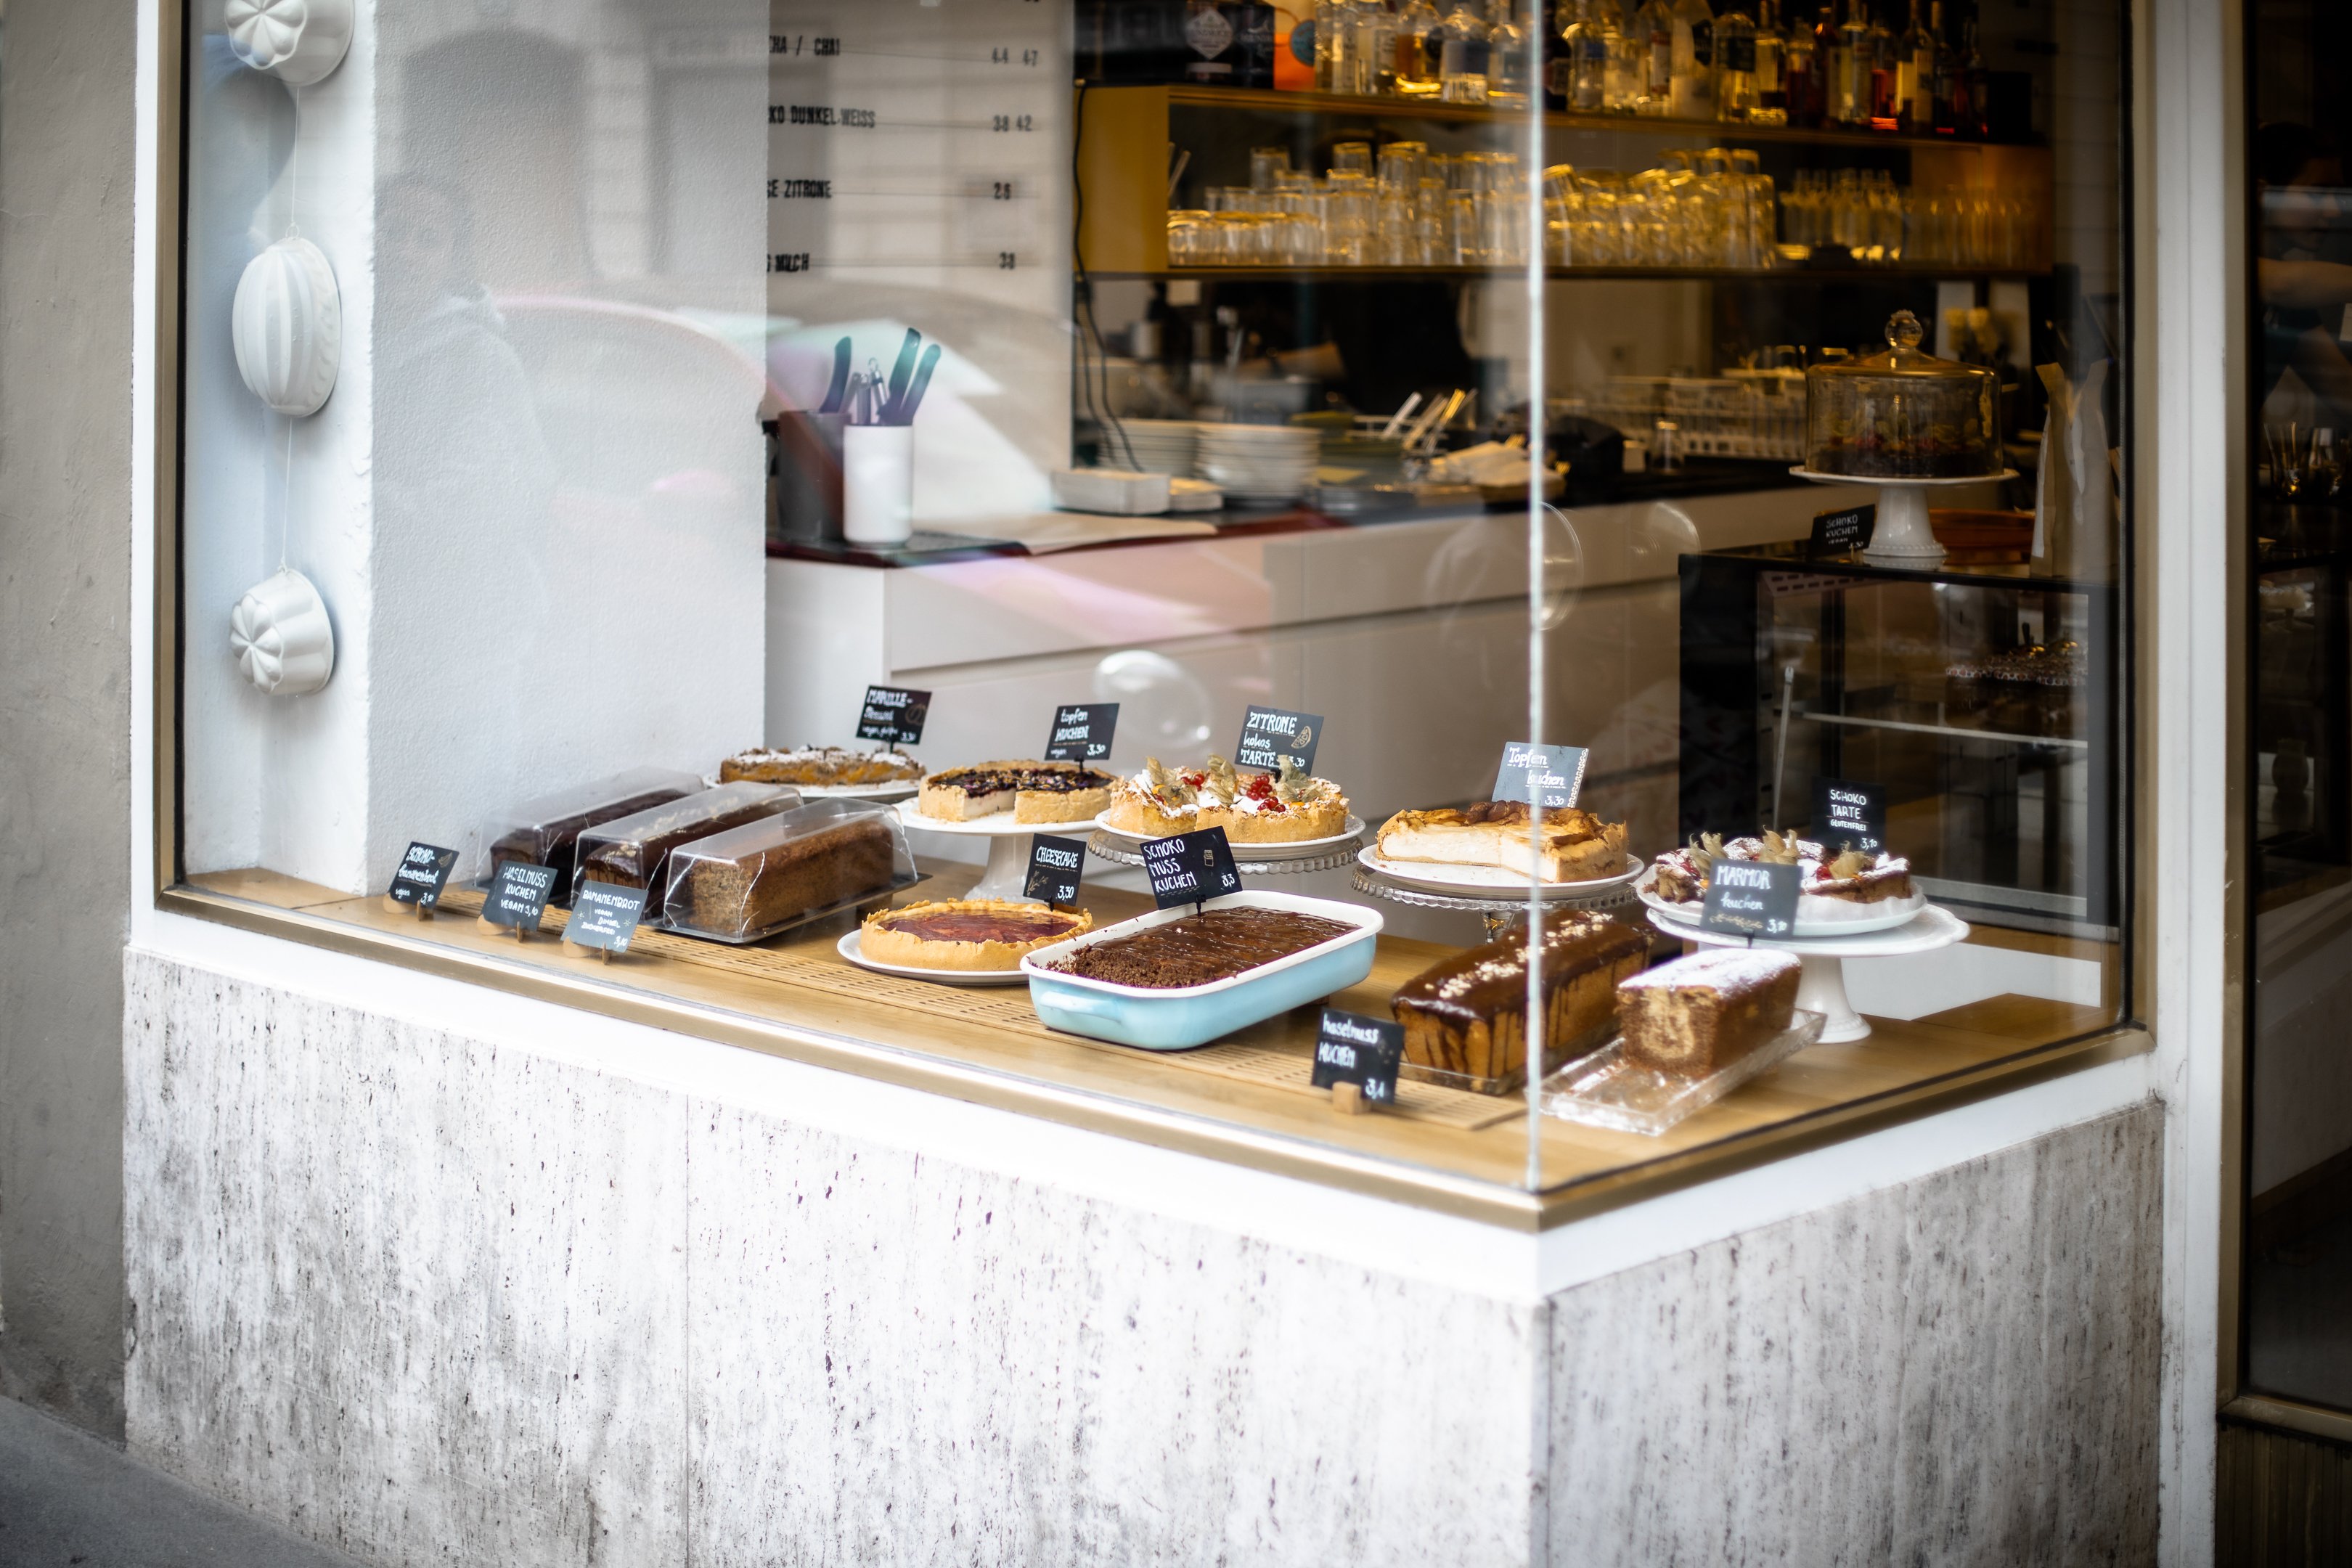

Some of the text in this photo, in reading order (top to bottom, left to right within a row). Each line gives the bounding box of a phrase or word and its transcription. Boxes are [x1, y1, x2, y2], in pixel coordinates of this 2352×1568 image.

[814, 38, 840, 56] CHAI
[841, 107, 875, 128] WEISS
[784, 180, 831, 198] ZITRONE
[1826, 514, 1858, 529] SCHOKO
[1826, 526, 1858, 538] KUCHEN
[1246, 711, 1297, 735] ZITRONE
[1243, 730, 1271, 749] kokos
[1241, 748, 1276, 767] TARTE
[1544, 795, 1565, 807] 3,30
[1830, 789, 1868, 806] SCHOKO
[1831, 804, 1861, 820] TARTE
[1830, 819, 1867, 832] GLUTENFREI
[1143, 838, 1185, 860] SCHOKO
[1860, 837, 1878, 851] 3,10
[1036, 845, 1079, 868] CHEESECAKE
[502, 865, 548, 889] HASELNUSS
[1148, 857, 1181, 878] NUSS
[1154, 870, 1198, 894] KUCHEN
[1715, 865, 1772, 890] MARMOR
[505, 882, 537, 902] KUCHEN
[582, 889, 641, 911] BANANENBROT
[1057, 885, 1074, 901] 3,30
[1720, 891, 1764, 910] kuchen
[500, 898, 525, 914] VEGAN
[1323, 1012, 1379, 1045] haselnuss
